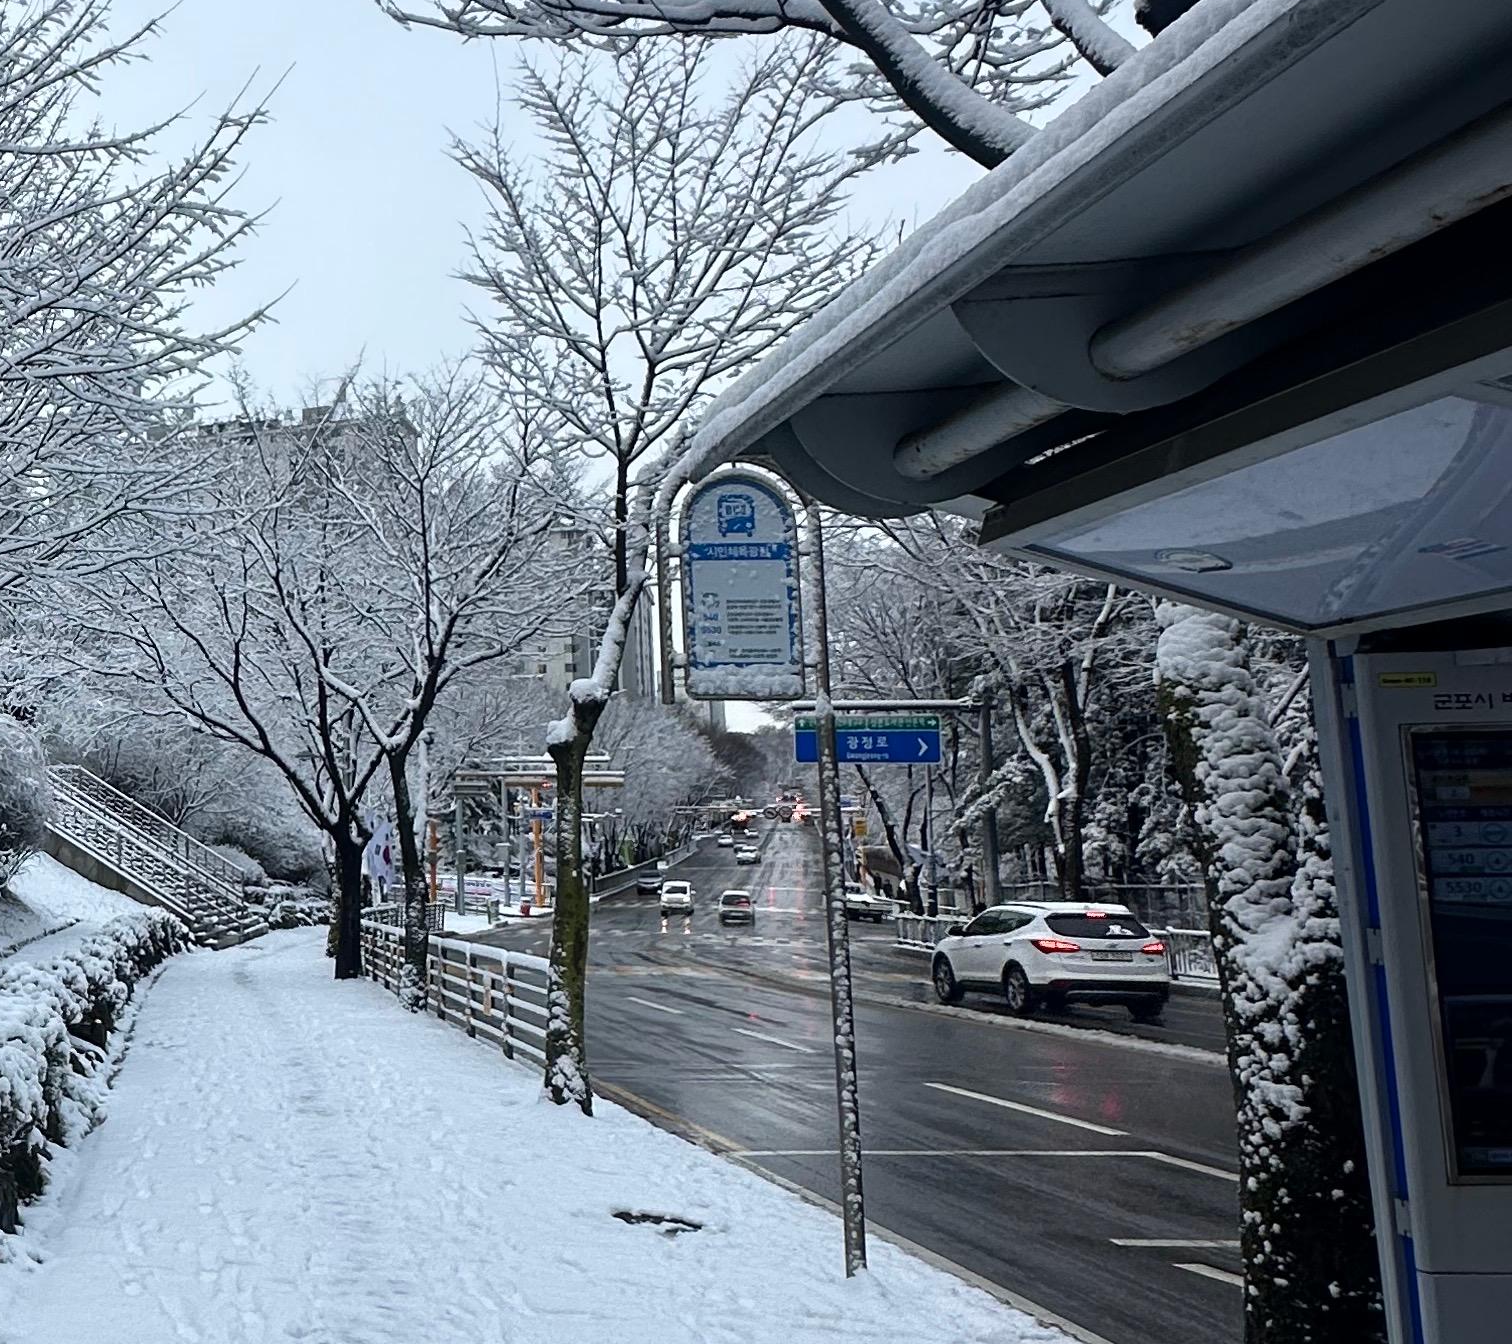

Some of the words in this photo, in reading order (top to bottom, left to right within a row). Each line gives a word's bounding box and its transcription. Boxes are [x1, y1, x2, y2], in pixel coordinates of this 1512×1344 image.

[1433, 693, 1494, 710] 군포시
[846, 736, 889, 750] 광정로
[1446, 881, 1482, 894] 5530
